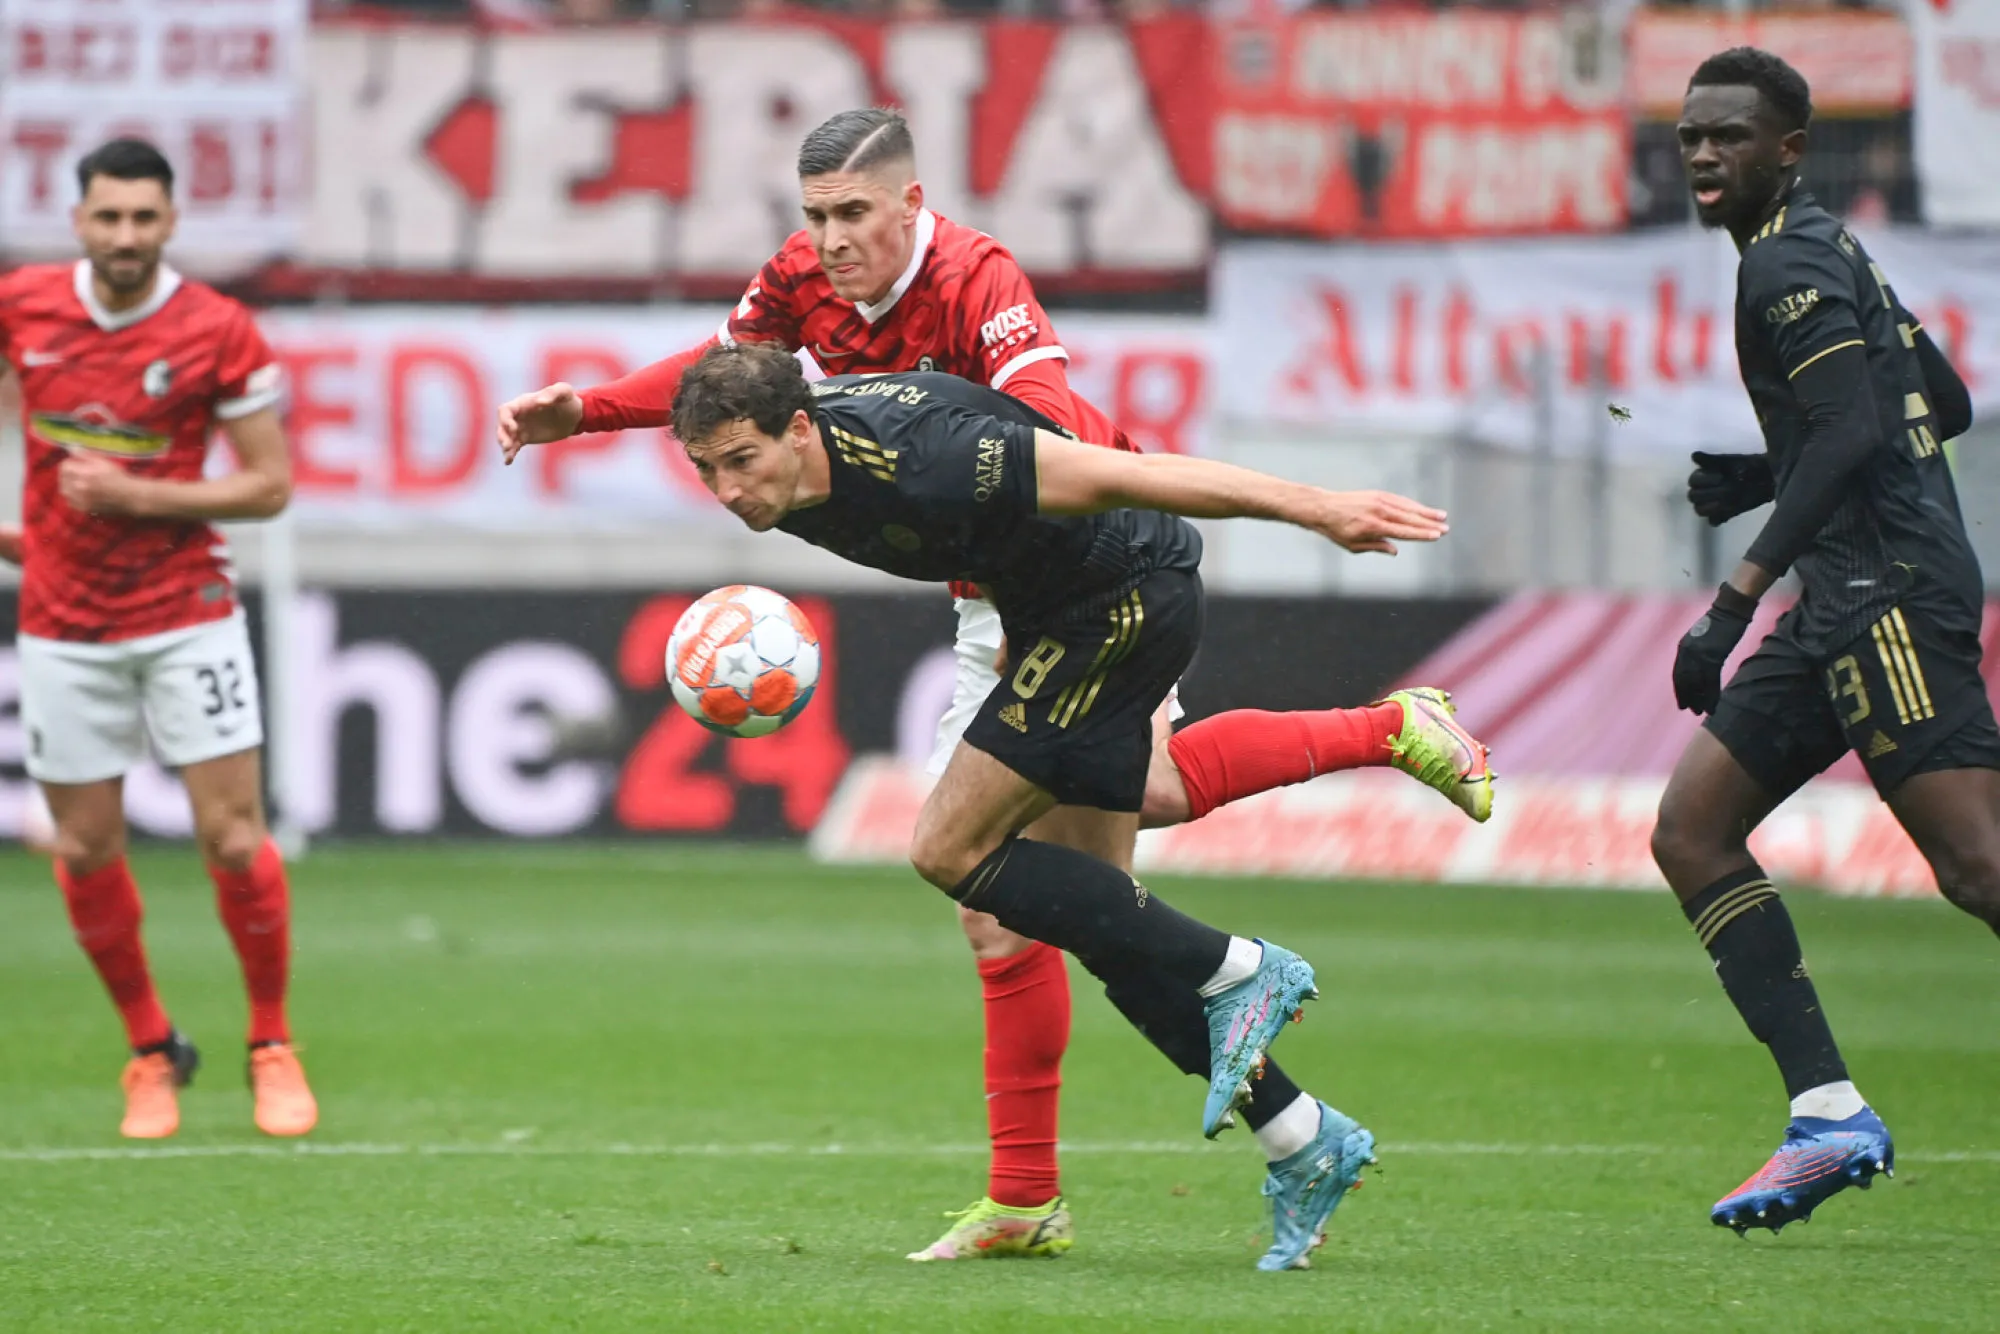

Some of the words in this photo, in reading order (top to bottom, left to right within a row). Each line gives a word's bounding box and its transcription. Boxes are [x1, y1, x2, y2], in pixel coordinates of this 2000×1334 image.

[10, 114, 282, 214] TBI
[981, 303, 1033, 347] ROSE
[1766, 288, 1820, 323] QATAR
[222, 338, 490, 498] ED
[897, 385, 929, 405] FC
[973, 437, 995, 502] QATAR
[197, 657, 246, 716] 32
[1011, 636, 1066, 699] 8
